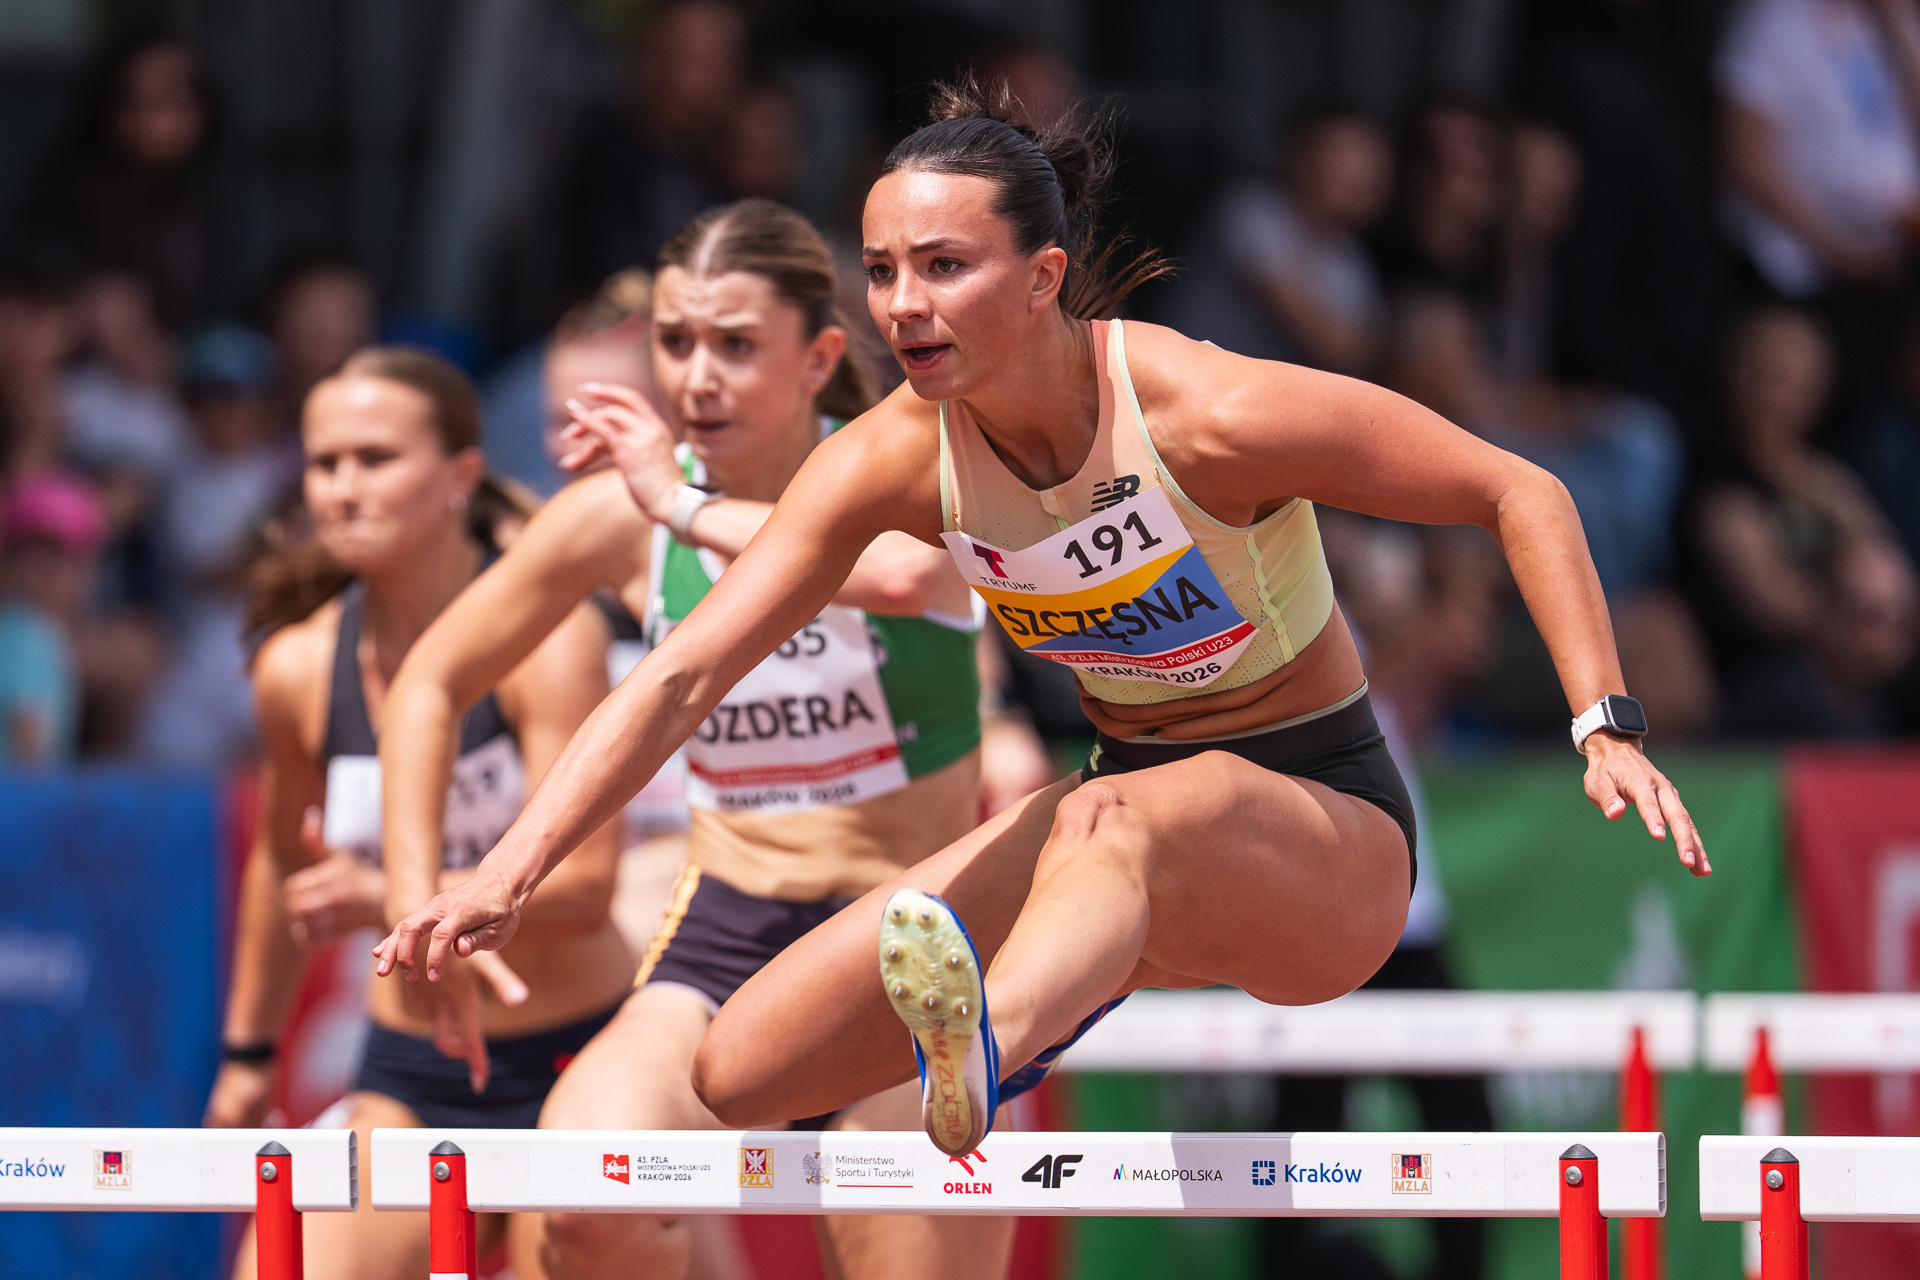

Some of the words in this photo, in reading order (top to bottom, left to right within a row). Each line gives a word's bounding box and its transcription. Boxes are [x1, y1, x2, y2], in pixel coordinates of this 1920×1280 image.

[1063, 510, 1163, 579] 191
[979, 576, 1038, 592] TRYUMF
[996, 575, 1220, 646] SZCZĘSNA
[1070, 654, 1098, 663] PZLA
[1099, 654, 1167, 668] Mistrzostwa
[1166, 645, 1207, 667] Polski
[1206, 635, 1234, 653] U23
[1084, 666, 1170, 682] KRAKÓW
[1170, 662, 1222, 683] 2026
[637, 1156, 648, 1164] 43.
[650, 1156, 668, 1164] PZLA
[835, 1155, 895, 1165] Ministerstwo
[637, 1171, 672, 1181] KRAKÓW
[673, 1173, 692, 1181] 2026
[835, 1167, 866, 1179] Sportu
[873, 1168, 915, 1179] Turystyki
[1021, 1154, 1084, 1189] 4F
[1132, 1169, 1223, 1182] MAŁOPOLSKA
[1284, 1162, 1363, 1183] Kraków
[97, 1176, 128, 1187] MZLA
[739, 1174, 772, 1187] PZLA
[1394, 1180, 1429, 1192] MZLA
[943, 1182, 992, 1194] ORLEN
